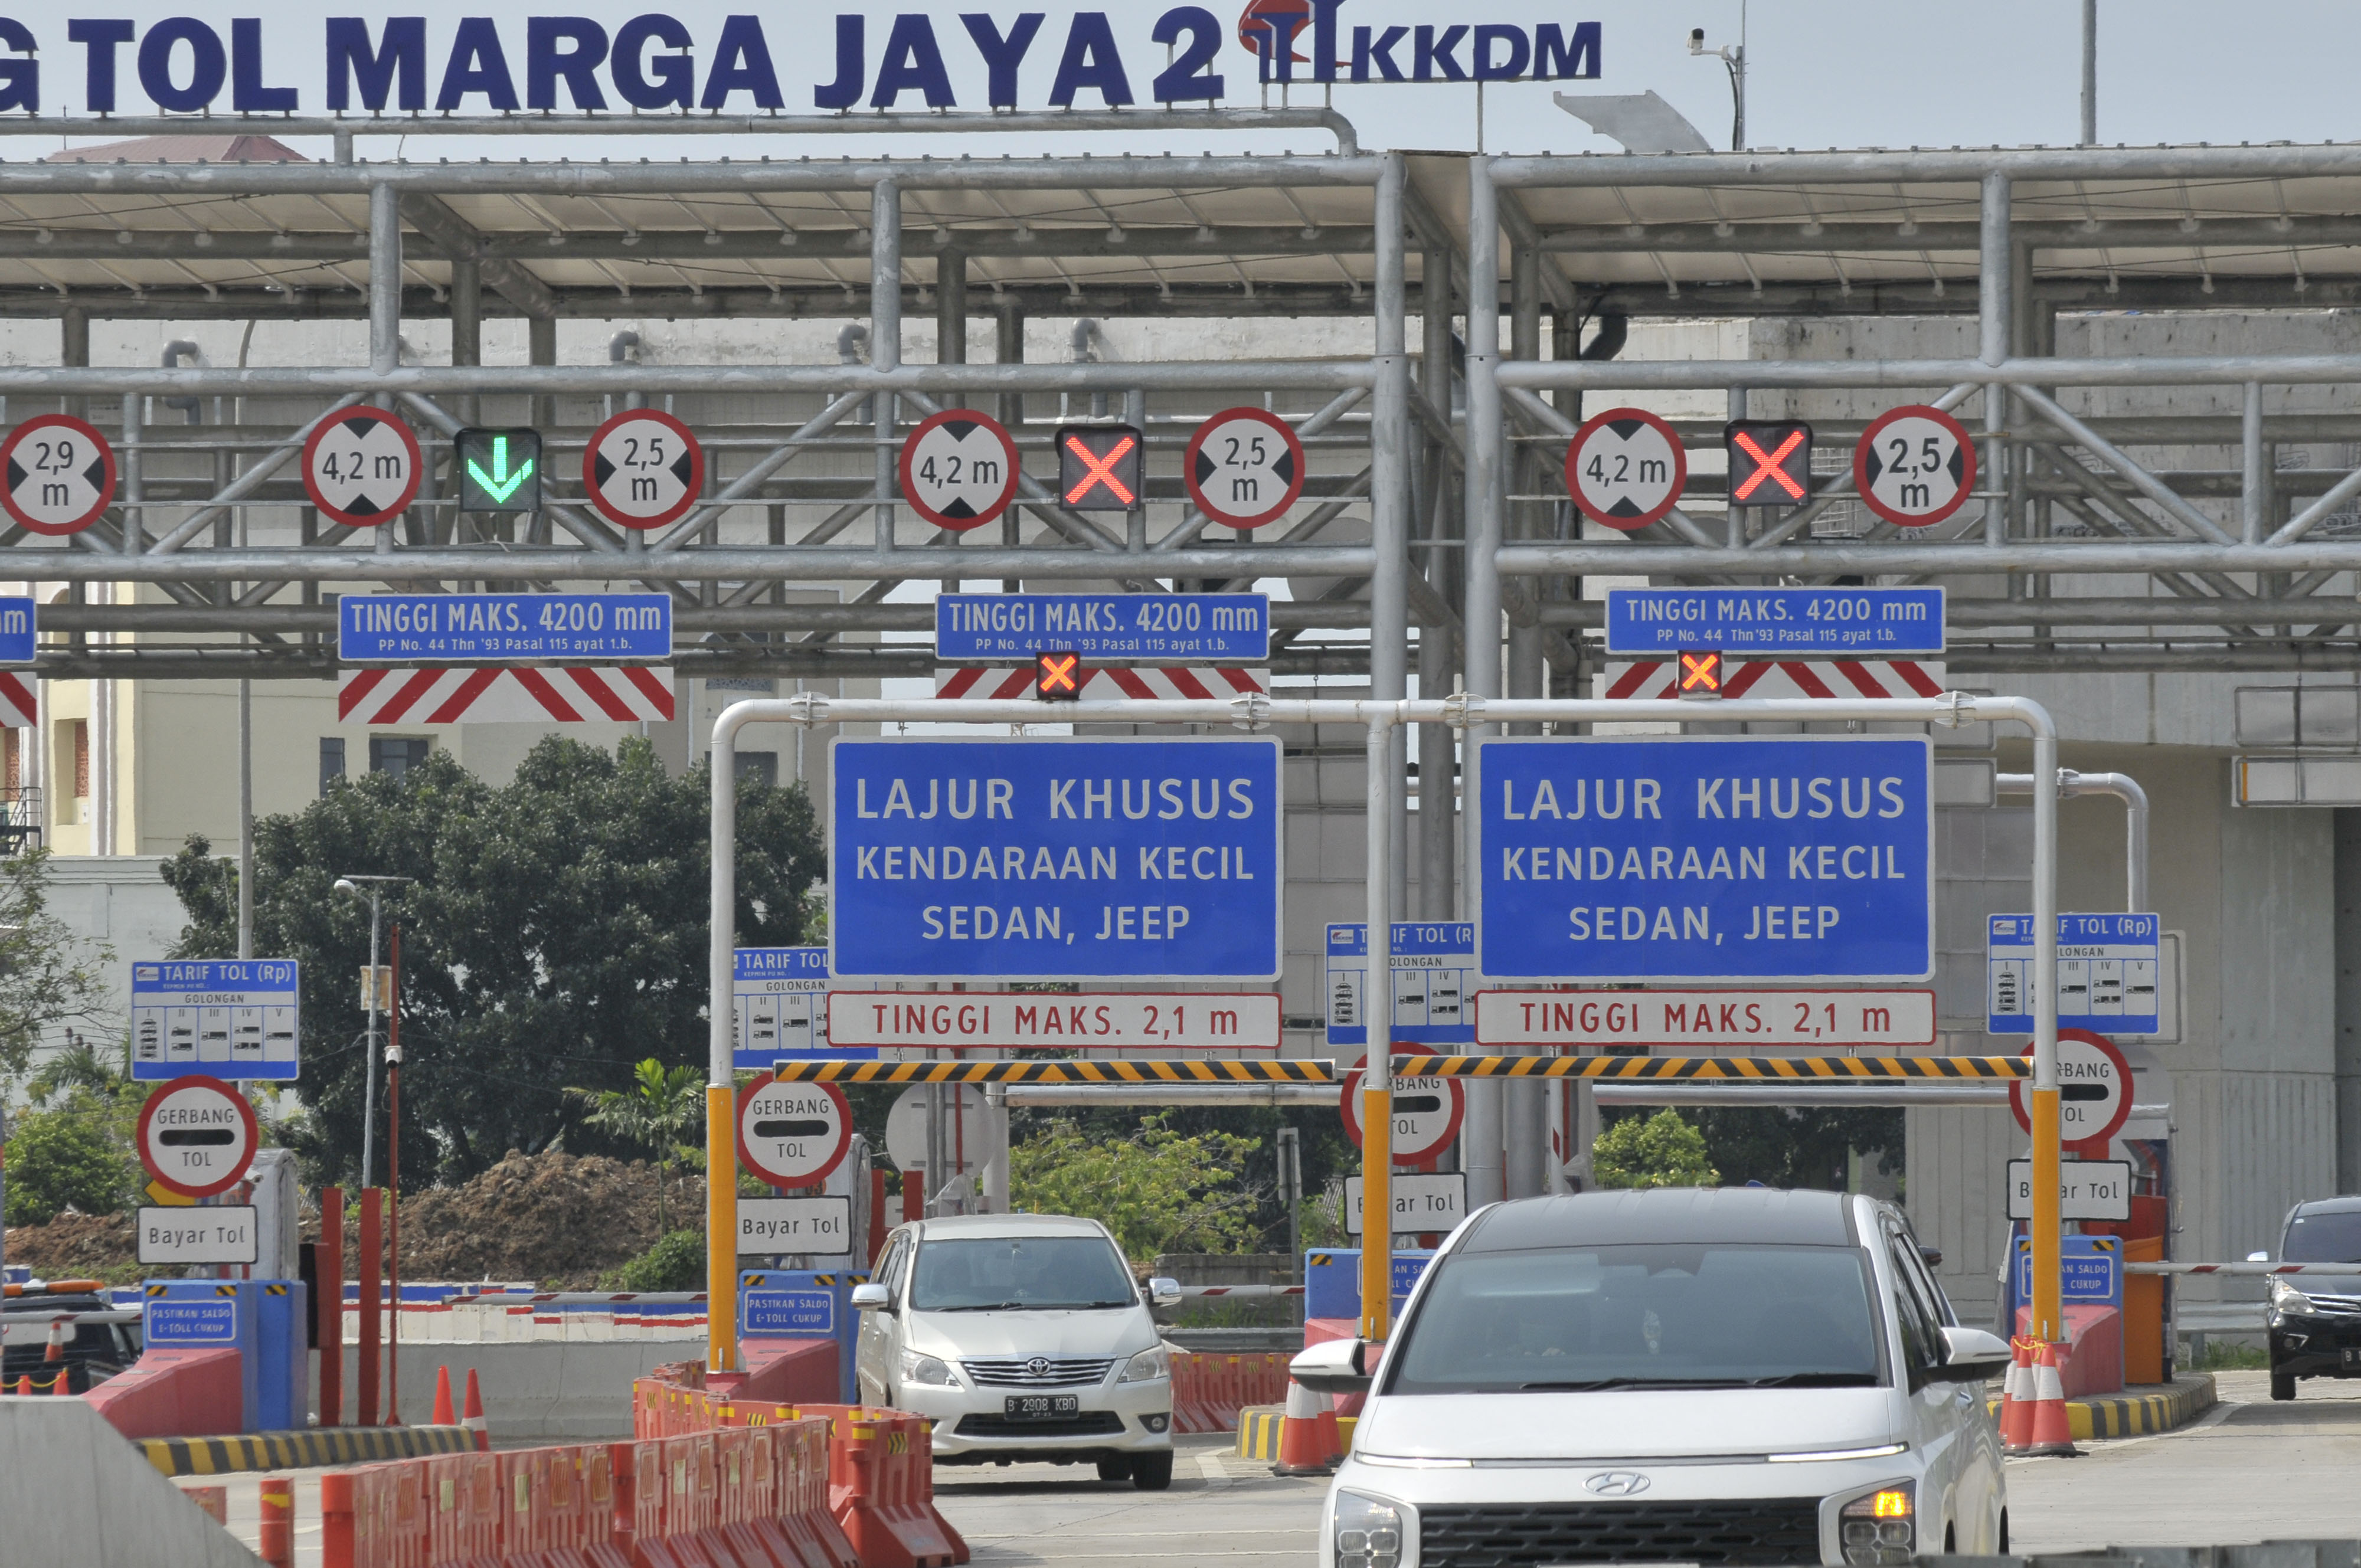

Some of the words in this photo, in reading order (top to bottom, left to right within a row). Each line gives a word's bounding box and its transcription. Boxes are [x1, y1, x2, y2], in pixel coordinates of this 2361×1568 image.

[68, 17, 299, 112] TOL
[326, 13, 786, 111] MARGA
[814, 12, 1135, 109] JAYA
[1151, 6, 1224, 102] 2
[1350, 21, 1602, 83] KKDM
[35, 441, 74, 476] 2,9
[623, 437, 664, 472] 2,5
[1224, 437, 1266, 470] 2,5
[1888, 437, 1941, 481] 2,5
[322, 451, 364, 486] 4,2
[374, 454, 401, 479] m
[919, 456, 963, 489] 4,2
[972, 460, 999, 484] m
[1586, 454, 1629, 488] 4,2
[1639, 460, 1666, 483] m
[41, 483, 70, 506] m
[631, 477, 658, 502] m
[1231, 477, 1258, 502] m
[1899, 483, 1930, 508] m
[351, 604, 437, 633] TINGGI
[447, 603, 528, 632] MAKS.
[538, 601, 604, 631] 4200
[614, 606, 661, 631] mm
[949, 604, 1035, 632] TINGGI
[1045, 603, 1124, 632] MAKS.
[1136, 602, 1201, 631] 4200
[1212, 607, 1258, 631] mm
[1626, 600, 1706, 621] TINGGI
[1716, 600, 1794, 621] MAKS.
[1806, 598, 1871, 621] 4200
[1882, 603, 1927, 620] mm
[0, 610, 26, 634] m
[1656, 629, 1675, 642] PP
[1678, 629, 1699, 642] No.
[1704, 629, 1723, 641] 44
[1731, 628, 1754, 641] Thn
[1755, 628, 1774, 641] '93
[1779, 628, 1814, 641] Pasal
[1819, 628, 1837, 641] 115
[1842, 629, 1871, 644] ayat
[1876, 628, 1896, 641] 1.b.
[379, 639, 395, 650] PP
[401, 639, 423, 650] No.
[429, 638, 445, 651] 44
[451, 638, 475, 650] Thn
[481, 638, 500, 650] '93
[505, 637, 542, 650] Pasal
[548, 637, 568, 650] 115
[574, 637, 604, 653] ayat
[610, 637, 633, 649] 1.b.
[975, 638, 995, 650] PP
[998, 638, 1019, 650] No.
[1025, 638, 1042, 650] 44
[1048, 638, 1072, 650] Thn
[1077, 638, 1097, 650] '93
[1102, 637, 1140, 650] Pasal
[1146, 638, 1165, 650] 115
[1170, 637, 1201, 653] ayat
[1206, 638, 1229, 650] 1.b.
[856, 778, 1014, 820] LAJUR
[1049, 778, 1255, 820] KHUSUS
[1503, 778, 1663, 821] LAJUR
[1697, 777, 1905, 819] KHUSUS
[856, 846, 1117, 880] KENDARAAN
[1140, 846, 1254, 880] KECIL
[1503, 846, 1766, 880] KENDARAAN
[1788, 844, 1906, 880] KECIL
[921, 905, 1076, 945] SEDAN,
[1094, 905, 1190, 940] JEEP
[1568, 906, 1724, 945] SEDAN,
[1743, 906, 1840, 940] JEEP
[2020, 919, 2068, 934] TIF
[2077, 919, 2109, 934] TOL
[2117, 917, 2152, 938] (Rp)
[1359, 928, 1407, 943] TIF
[1416, 928, 1447, 942] TOL
[1456, 926, 1471, 944] (R
[2057, 947, 2104, 957] LONGAN
[744, 954, 790, 968] TARIF
[799, 953, 828, 968] TOL
[1389, 957, 1442, 967] OLONGAN
[2005, 962, 2008, 970] I
[2068, 962, 2078, 971] III
[2101, 961, 2111, 970] IV
[2137, 962, 2143, 970] V
[164, 965, 210, 980] TARIF
[219, 965, 249, 980] TOL
[257, 964, 292, 983] (Rp)
[1342, 973, 1345, 981] I
[1406, 971, 1416, 981] III
[1439, 971, 1450, 980] IV
[766, 981, 825, 991] GOLONGAN
[185, 994, 244, 1003] GOLONGAN
[760, 997, 766, 1005] II
[790, 996, 800, 1004] III
[210, 1009, 219, 1017] III
[242, 1009, 252, 1017] IV
[276, 1008, 282, 1016] V
[872, 1004, 990, 1035] TINGGI
[1014, 1006, 1121, 1036] MAKS.
[1143, 1006, 1185, 1040] 2,1
[1209, 1009, 1238, 1035] m
[1519, 1003, 1640, 1033] TINGGI
[1663, 1003, 1772, 1033] MAKS.
[1794, 1003, 1837, 1038] 2,1
[1862, 1007, 1892, 1033] m
[2056, 1062, 2110, 1078] RBANG
[1362, 1077, 1440, 1091] BANG
[753, 1099, 829, 1115] GERBANG
[2061, 1107, 2085, 1122] OL
[157, 1108, 234, 1124] GERBANG
[1392, 1119, 1418, 1134] OL
[777, 1143, 806, 1158] TOL
[182, 1151, 211, 1167] TOL
[2019, 1181, 2078, 1199] Bar
[2089, 1181, 2117, 1199] Tol
[1425, 1193, 1453, 1211] Tol
[743, 1219, 799, 1239] Bayar
[812, 1216, 839, 1233] Tol
[149, 1227, 205, 1248] Bayar
[217, 1226, 244, 1243] Tol
[2078, 1265, 2107, 1274] SALDO
[2071, 1280, 2101, 1289] CUKUP
[749, 1299, 794, 1308] PASTIKAN
[799, 1299, 828, 1308] SALDO
[756, 1314, 787, 1323] E-TOLL
[792, 1314, 822, 1323] CUKUP
[1008, 1400, 1015, 1411] B
[1022, 1399, 1048, 1411] 2908
[1055, 1398, 1075, 1410] KBD
